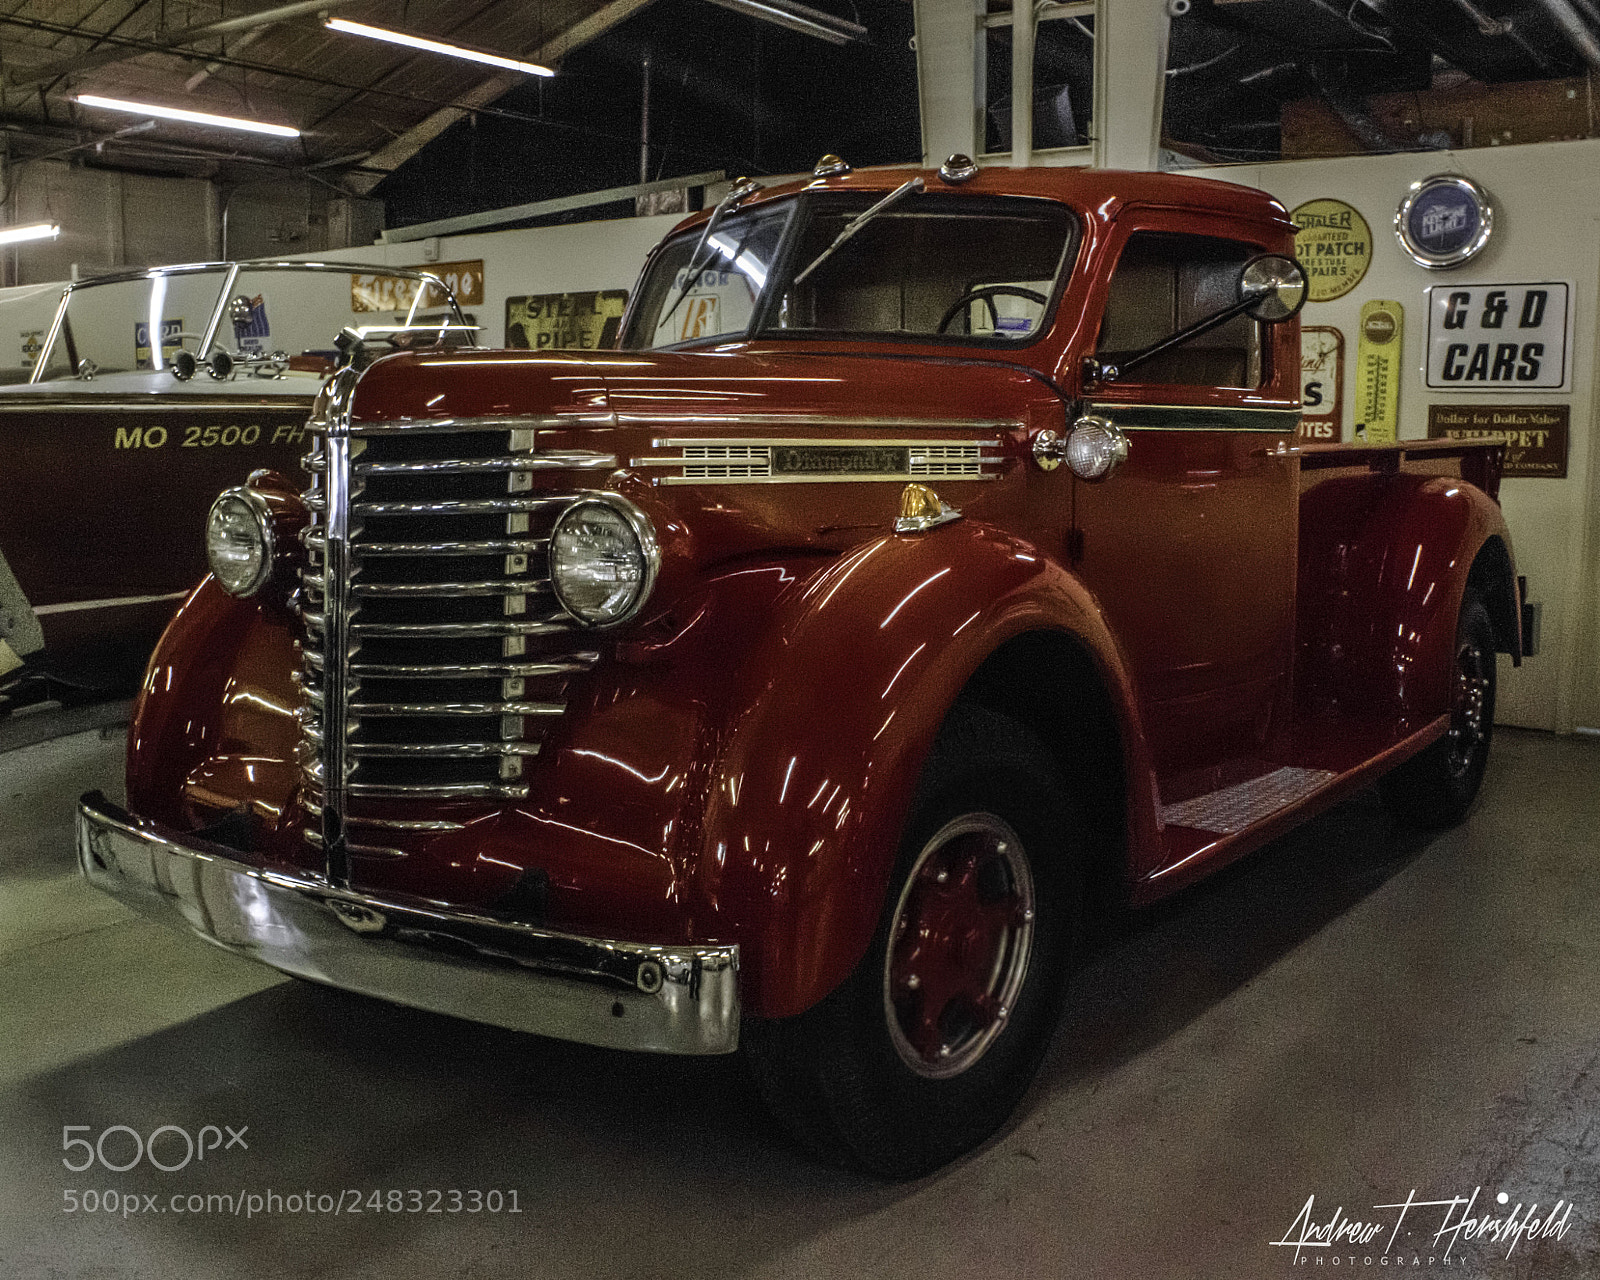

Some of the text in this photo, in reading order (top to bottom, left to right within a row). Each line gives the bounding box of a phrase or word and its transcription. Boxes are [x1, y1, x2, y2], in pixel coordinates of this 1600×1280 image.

[1296, 241, 1365, 257] OT PATCH
[1304, 267, 1347, 277] EPAIRS
[1443, 290, 1548, 330] G & D
[1442, 342, 1545, 381] CARS
[1473, 413, 1489, 424] for
[1492, 413, 1528, 424] Dollar
[114, 426, 168, 449] MO
[181, 425, 261, 448] 2500
